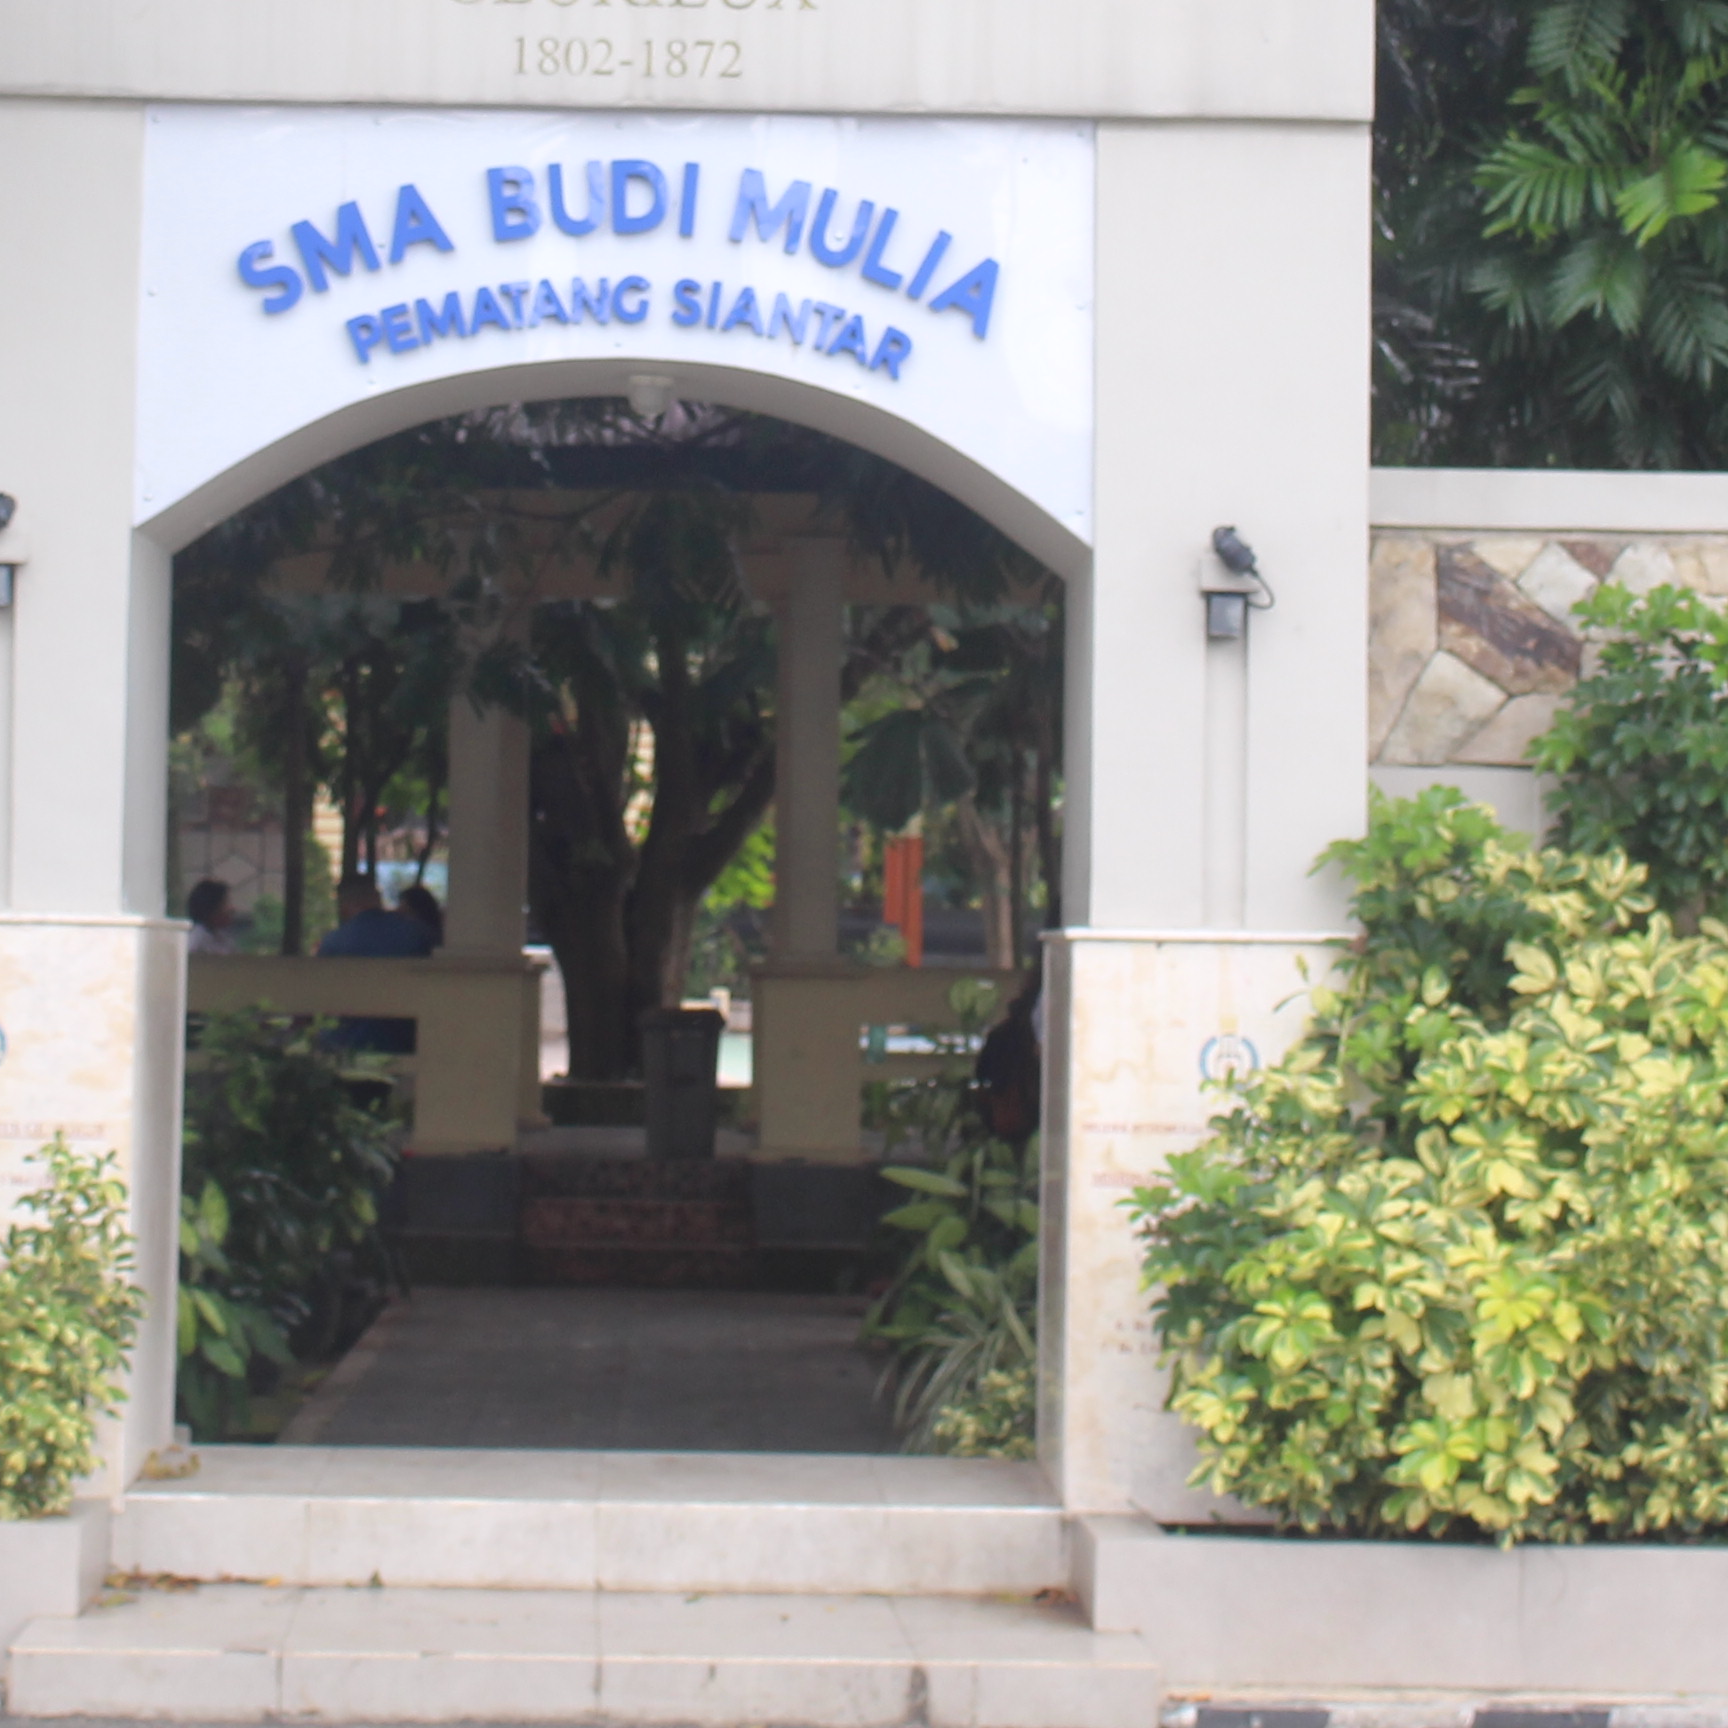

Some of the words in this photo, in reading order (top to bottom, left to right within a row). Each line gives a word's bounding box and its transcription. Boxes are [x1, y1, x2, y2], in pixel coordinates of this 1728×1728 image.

[513, 35, 744, 79] 1802-1872
[235, 182, 456, 316] SMA
[485, 157, 701, 243] BUDI
[729, 167, 1001, 340] MULIA
[344, 274, 652, 365] PEMATANG
[670, 277, 914, 381] SIANTAR
